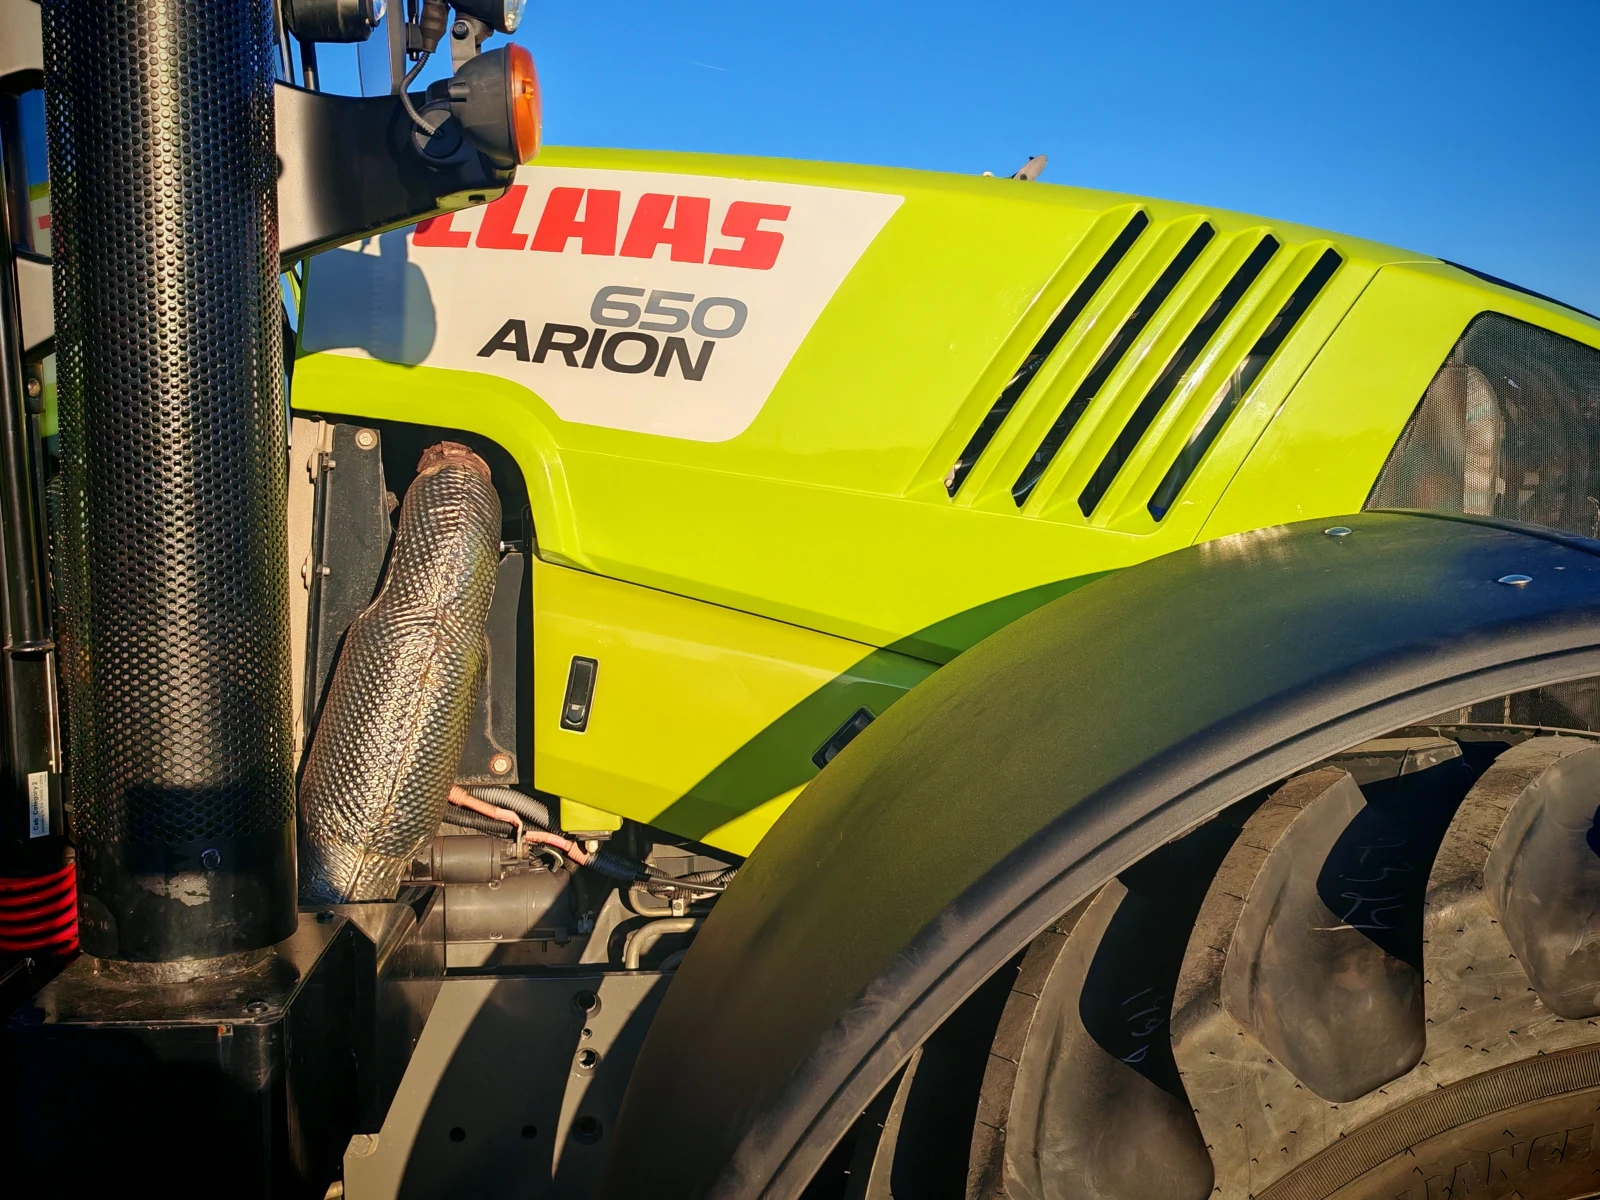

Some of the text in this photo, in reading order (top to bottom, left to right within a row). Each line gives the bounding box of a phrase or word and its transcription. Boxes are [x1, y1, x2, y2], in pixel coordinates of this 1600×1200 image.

[589, 285, 749, 338] 650
[476, 318, 716, 382] ARION
[31, 786, 39, 816] Category
